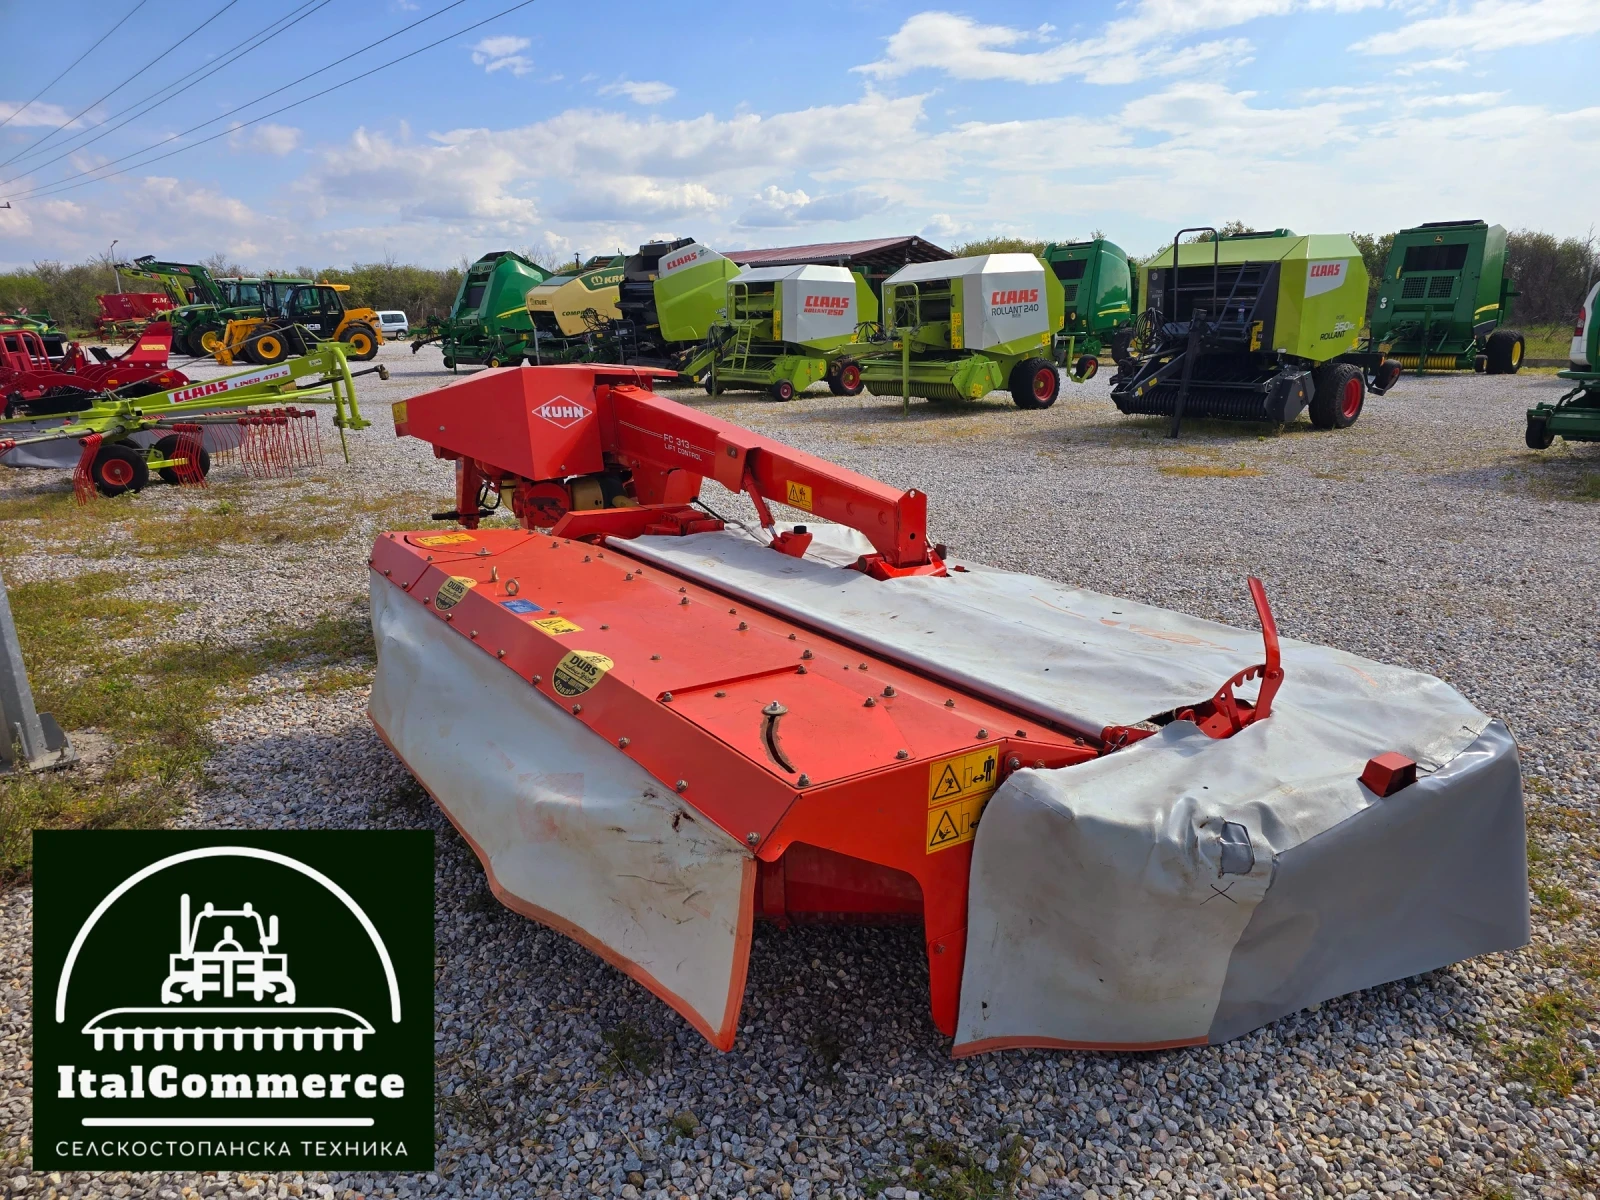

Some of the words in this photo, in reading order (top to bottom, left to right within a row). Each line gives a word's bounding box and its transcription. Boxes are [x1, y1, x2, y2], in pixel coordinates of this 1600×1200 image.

[667, 252, 697, 270] CLAAS
[1310, 264, 1340, 277] CLAAS
[604, 275, 624, 284] KRO
[805, 296, 849, 308] CLAAS
[991, 289, 1038, 305] CLAAS
[991, 305, 1022, 316] ROLLANT
[1023, 304, 1039, 313] 240
[1320, 330, 1345, 340] ROLLANT
[173, 380, 229, 403] CLAAS
[234, 377, 260, 388] LINER
[263, 372, 279, 381] 470
[541, 406, 584, 418] KUHN
[663, 433, 674, 444] FC
[676, 437, 690, 448] 313
[664, 443, 676, 453] LIFT
[677, 447, 702, 461] CONTROL
[447, 580, 464, 594] DUBS
[569, 655, 598, 676] DUBS
